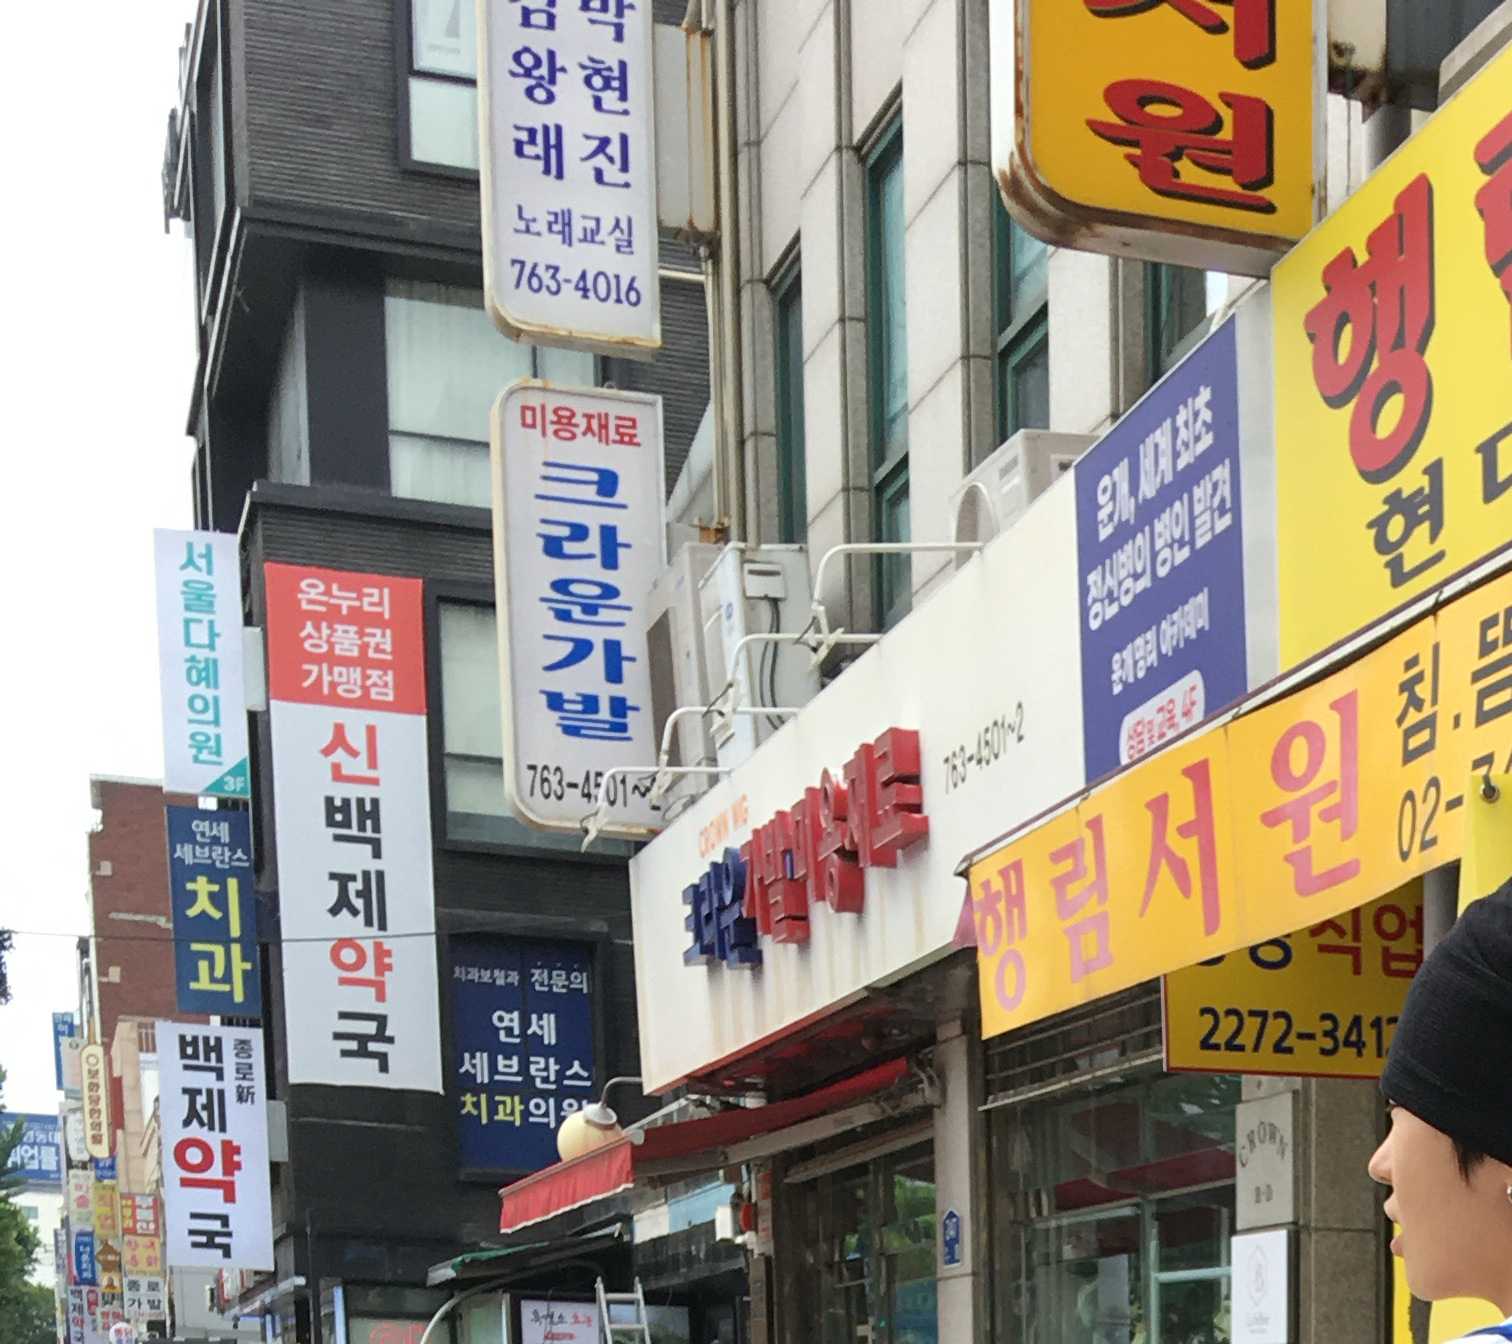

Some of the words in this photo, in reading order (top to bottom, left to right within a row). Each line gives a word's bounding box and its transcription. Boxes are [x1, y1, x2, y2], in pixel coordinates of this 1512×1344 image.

[513, 204, 634, 255] 노래교실
[511, 258, 641, 307] 763-4016
[520, 404, 641, 447] 미용재료
[1176, 385, 1214, 472] 최초
[1193, 457, 1232, 550] 발견
[297, 578, 390, 619] 온누리
[534, 461, 640, 742] 크라운가발
[179, 542, 223, 766] 서울다혜의원
[300, 620, 392, 660] 상품권
[301, 663, 394, 702] 가맹점
[224, 775, 244, 792] 3F
[192, 820, 229, 842] 연세
[975, 687, 1362, 1014] 행림서원
[174, 843, 250, 868] 세브란스
[318, 722, 396, 1074] 신백제약국
[185, 875, 251, 1004] 치과
[530, 966, 588, 994] 전문의
[492, 1010, 557, 1046] 연세
[459, 1052, 592, 1090] 세브란스
[173, 1034, 242, 1259] 백제약국
